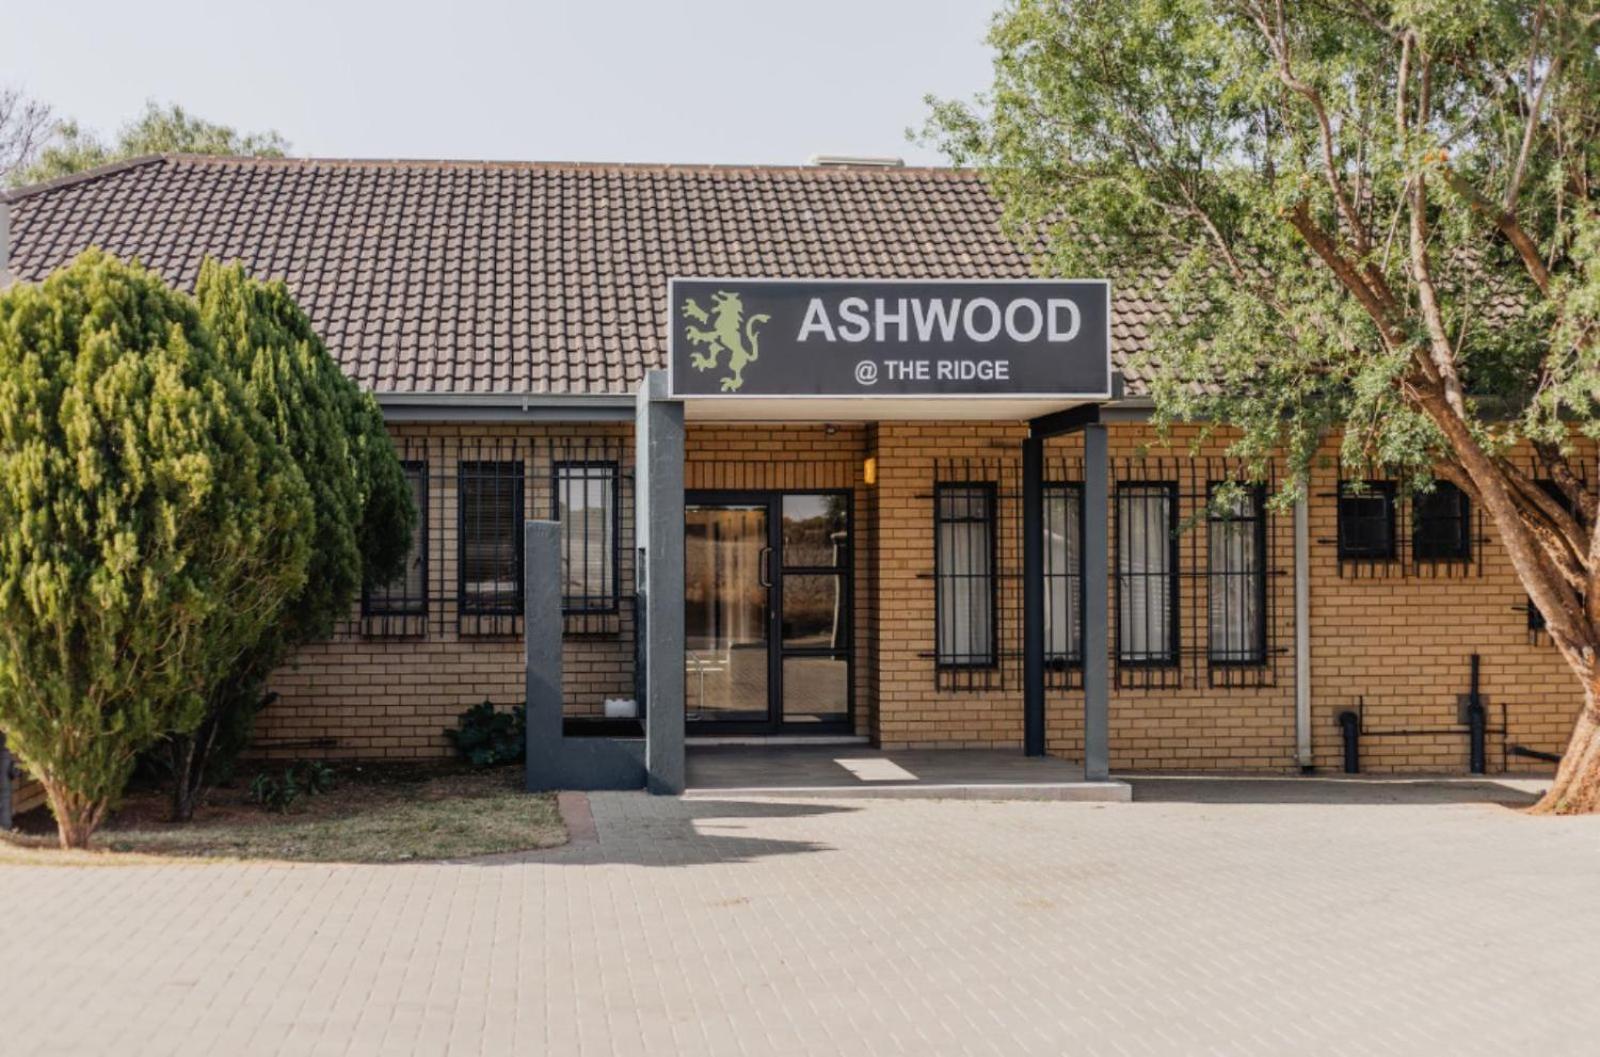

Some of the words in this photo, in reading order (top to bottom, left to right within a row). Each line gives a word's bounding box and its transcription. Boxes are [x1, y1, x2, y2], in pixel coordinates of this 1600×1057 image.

[797, 297, 1081, 342] ASHWOOD
[854, 360, 878, 385] @
[883, 361, 930, 380] THE
[937, 360, 1009, 381] RIDGE
